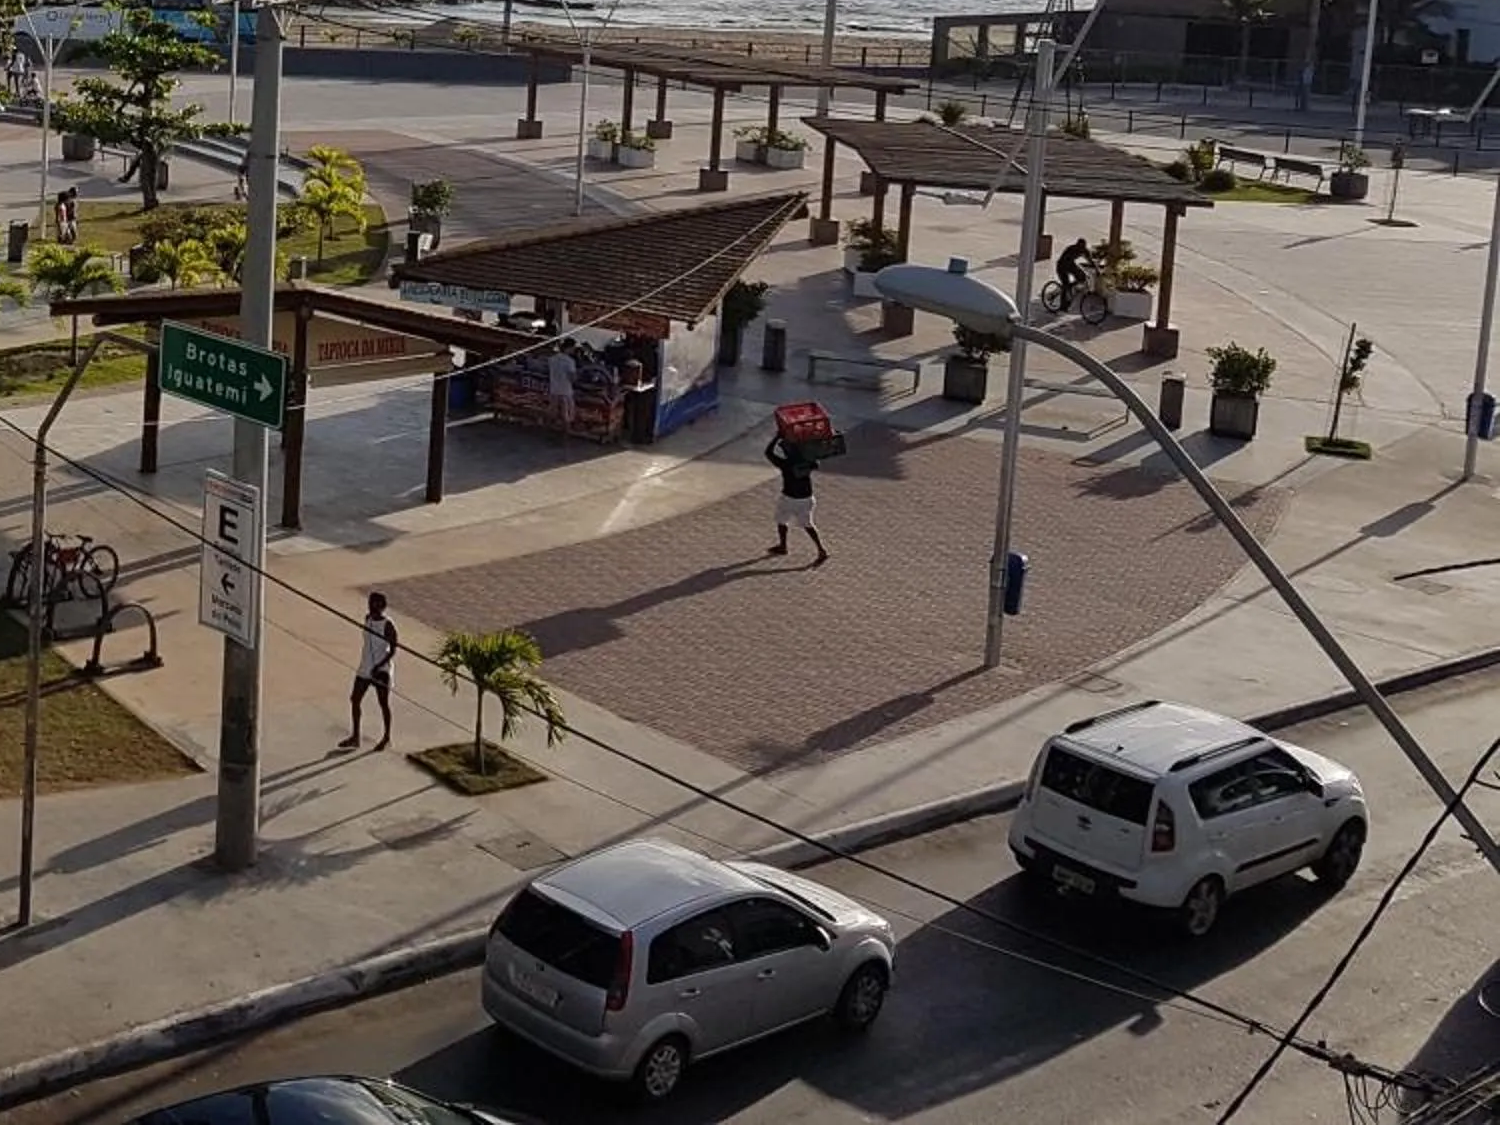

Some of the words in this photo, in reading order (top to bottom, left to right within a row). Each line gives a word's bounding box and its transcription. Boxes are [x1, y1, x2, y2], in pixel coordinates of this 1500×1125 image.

[185, 342, 248, 376] Brotas
[167, 363, 248, 405] Iguatemi
[219, 504, 239, 545] E
